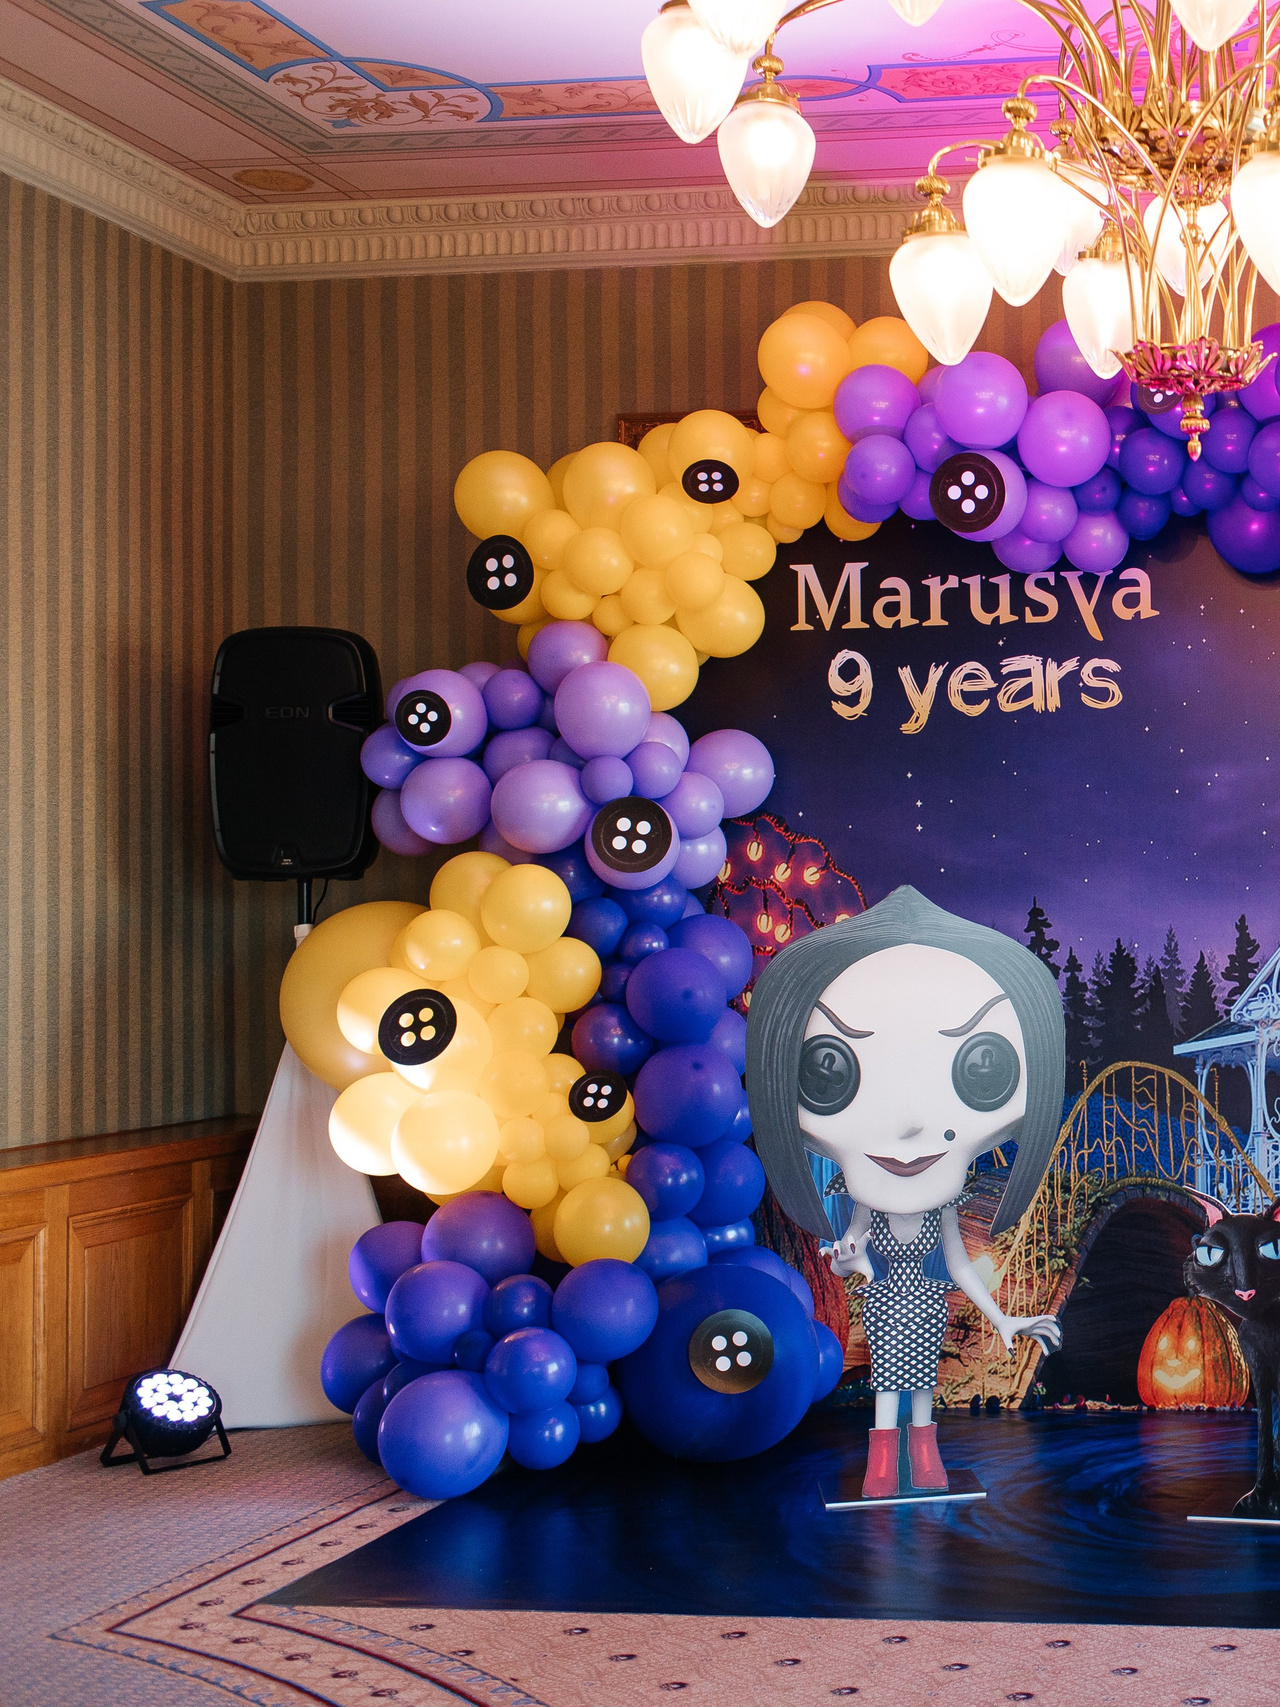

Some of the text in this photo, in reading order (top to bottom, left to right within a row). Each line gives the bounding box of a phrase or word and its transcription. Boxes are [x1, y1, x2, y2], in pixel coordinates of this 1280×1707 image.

[789, 562, 1160, 641] Marusya
[266, 706, 308, 718] EON
[828, 648, 1123, 735] 9 years
